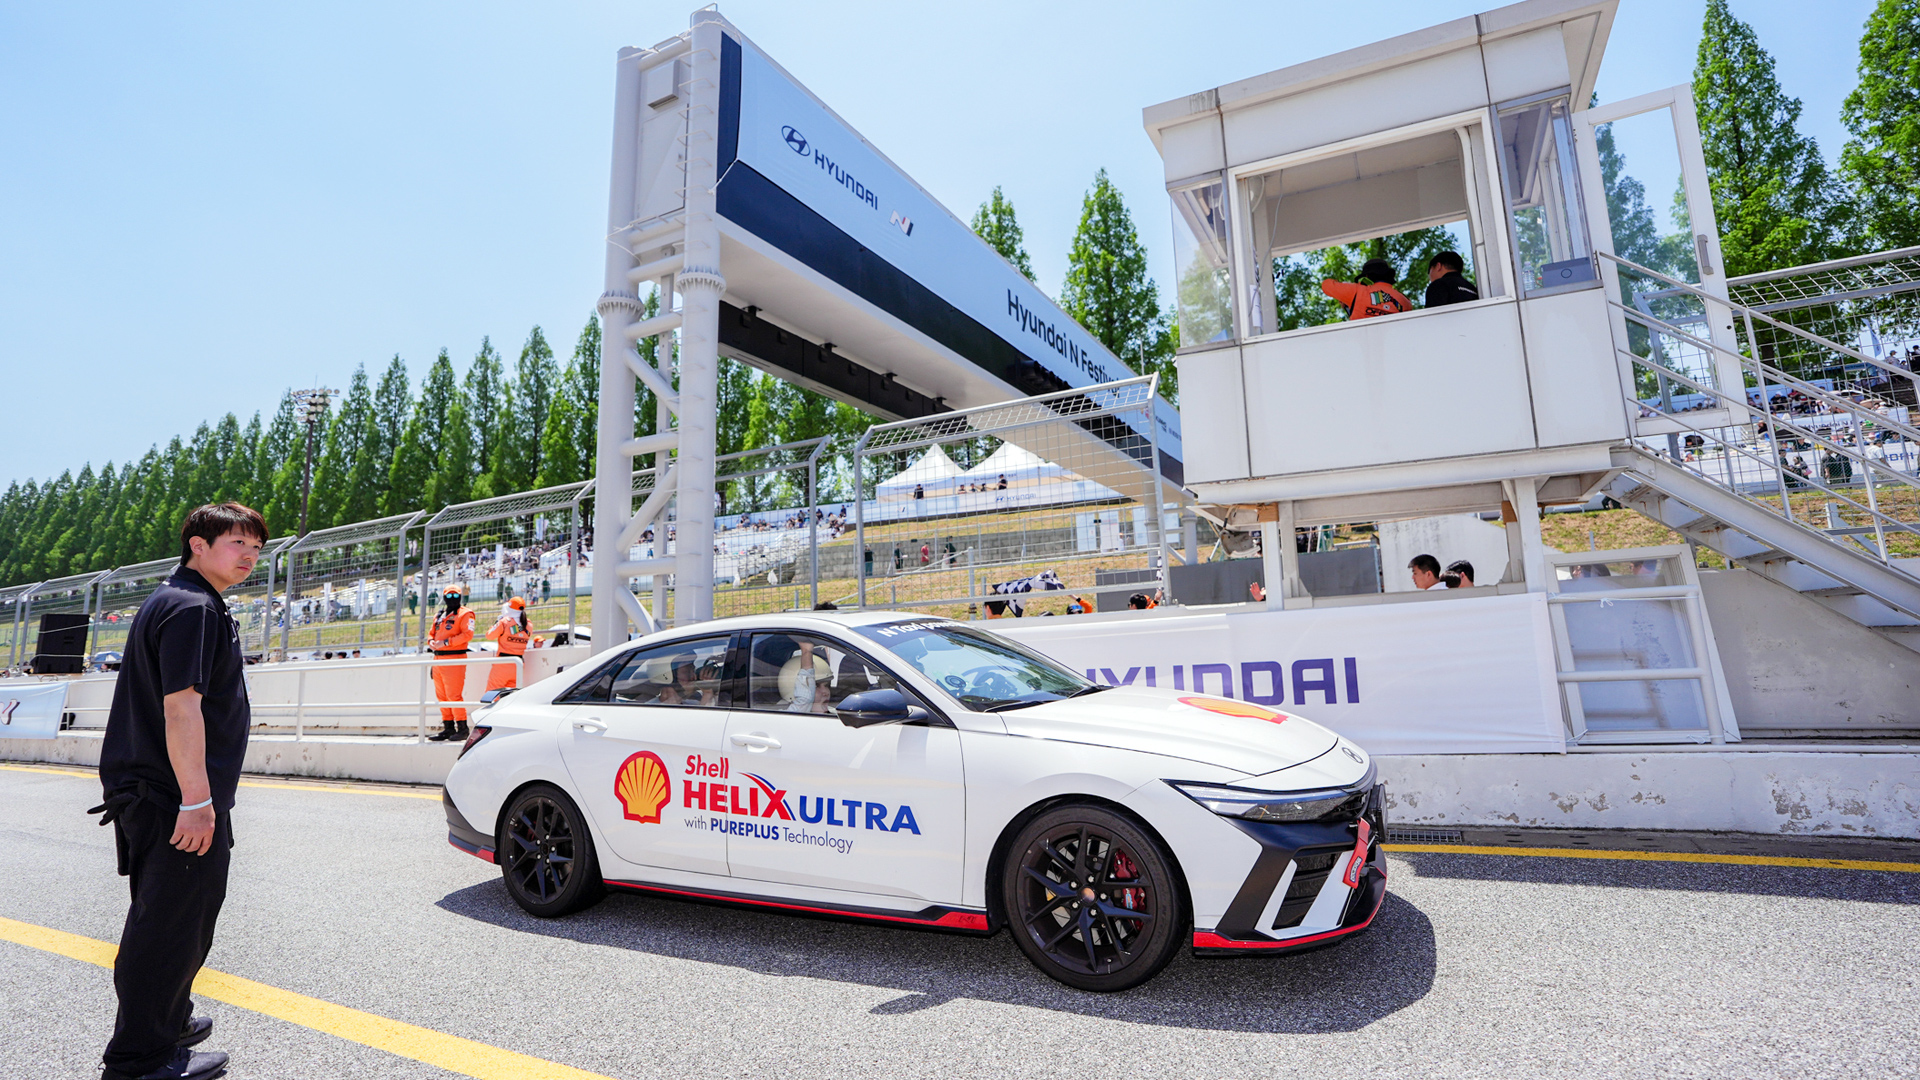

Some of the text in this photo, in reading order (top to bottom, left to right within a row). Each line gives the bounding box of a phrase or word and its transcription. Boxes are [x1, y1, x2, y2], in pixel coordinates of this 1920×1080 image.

[814, 148, 878, 211] HYUNDAI
[1007, 288, 1067, 358] Hyundai
[1069, 339, 1079, 368] N
[877, 628, 898, 637] N
[1086, 657, 1360, 706] NDAI
[684, 754, 729, 779] Shell
[683, 772, 922, 835] HELIX ULTRA
[684, 817, 854, 854] with PUREPLUS Technology
